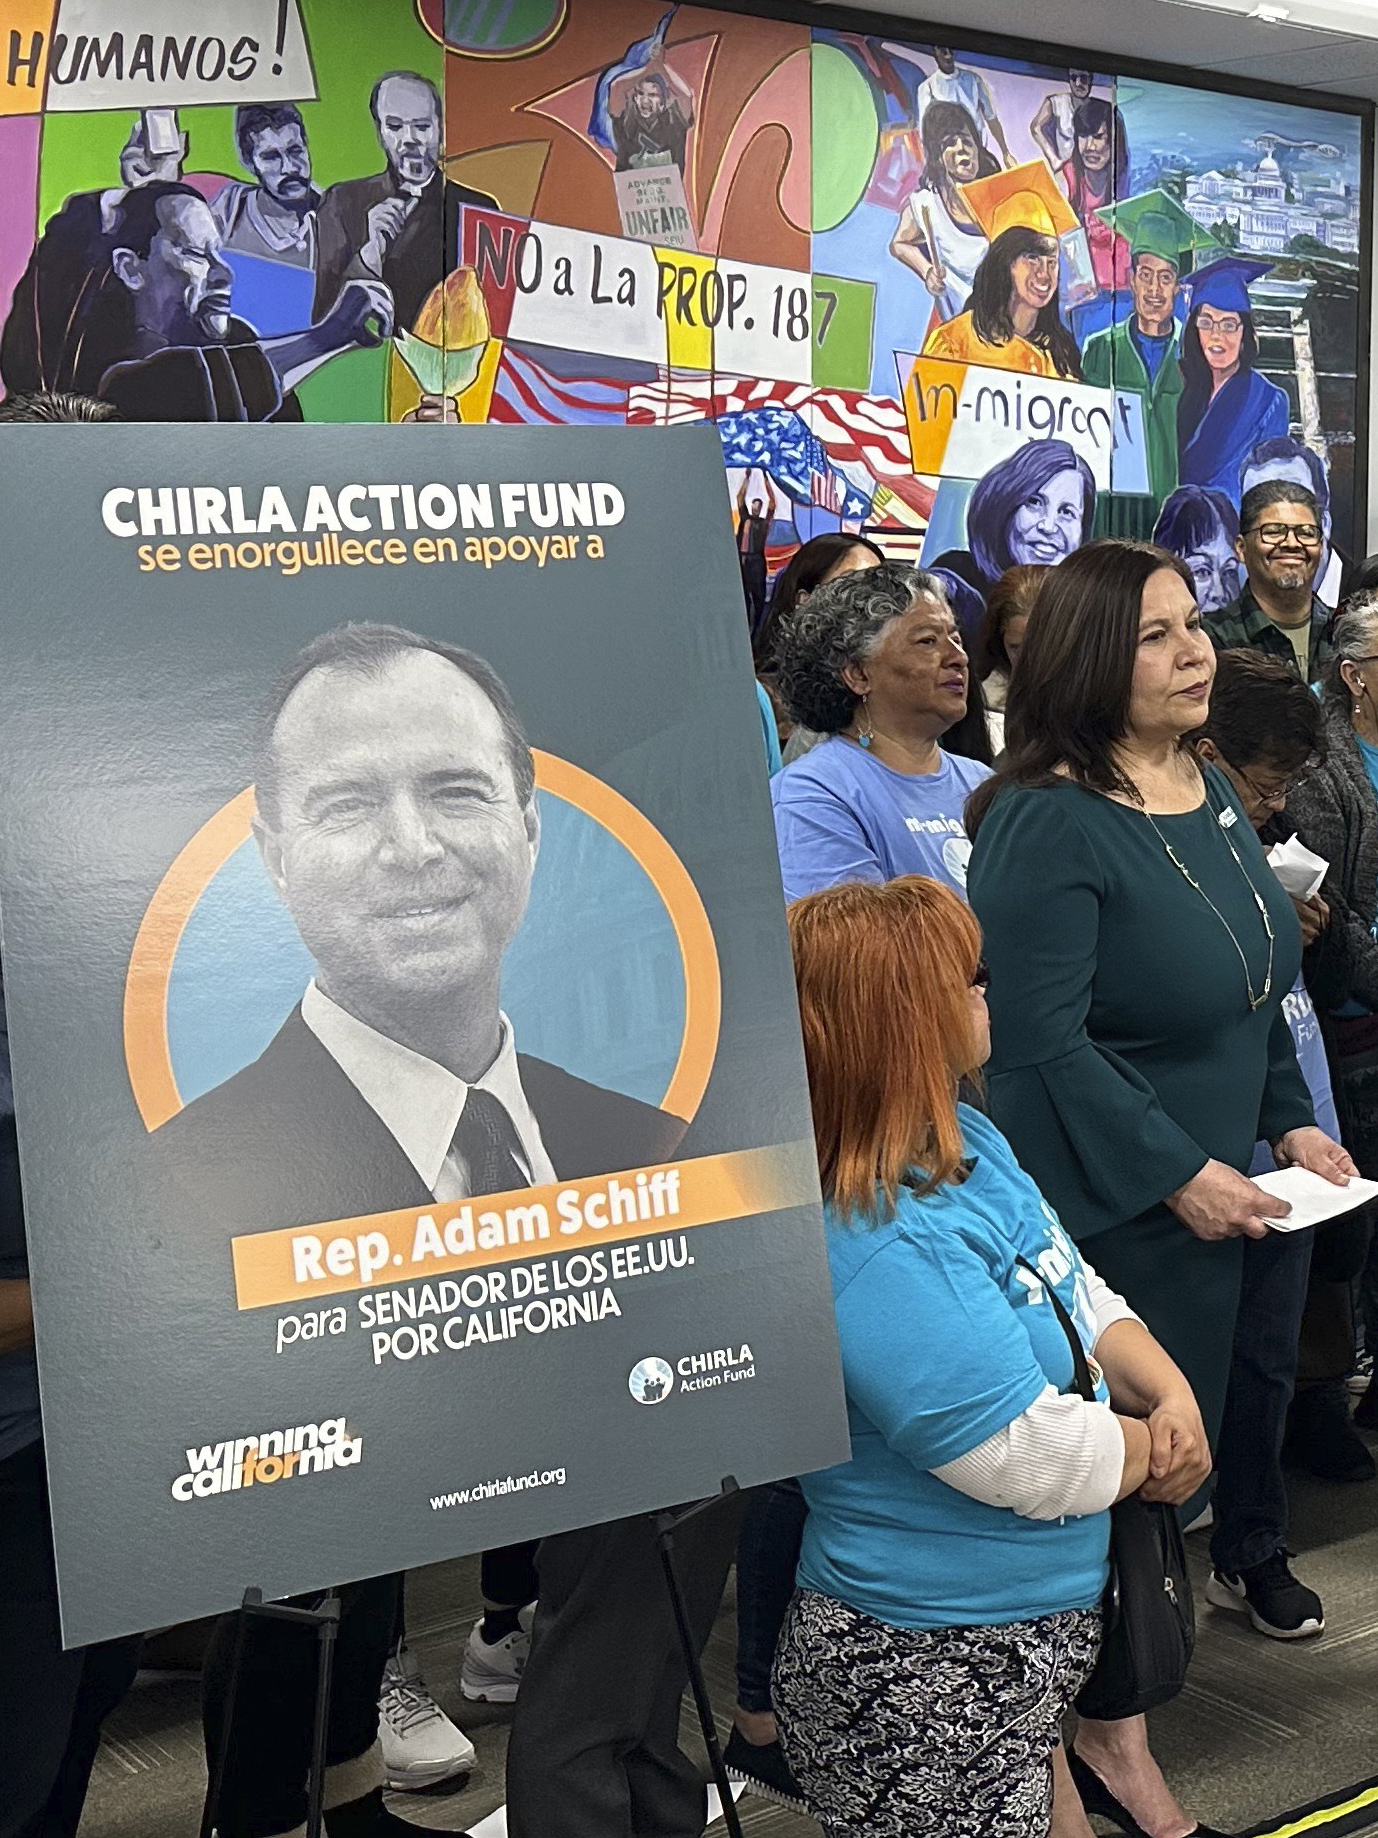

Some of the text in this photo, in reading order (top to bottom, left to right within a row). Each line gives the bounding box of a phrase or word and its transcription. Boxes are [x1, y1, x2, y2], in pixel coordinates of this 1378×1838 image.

[628, 177, 672, 189] ADVANCE
[625, 207, 688, 236] UNFAIR
[476, 219, 838, 348] NO a La PROP. 187
[101, 482, 626, 537] CHIRLA ACTION FUND
[138, 534, 605, 574] se enorgullece en apoyar a
[291, 1168, 681, 1284] Rep. Adam Schiff
[275, 1235, 696, 1354] para SENADOR DE LOS EE.UU.
[372, 1287, 622, 1365] POR CALIFORNIA
[677, 1344, 754, 1376] CHIRLA
[680, 1364, 756, 1393] Action Fund
[171, 1436, 363, 1501] california
[186, 1416, 348, 1474] winning
[430, 1466, 567, 1510] www.chirlafund.org
